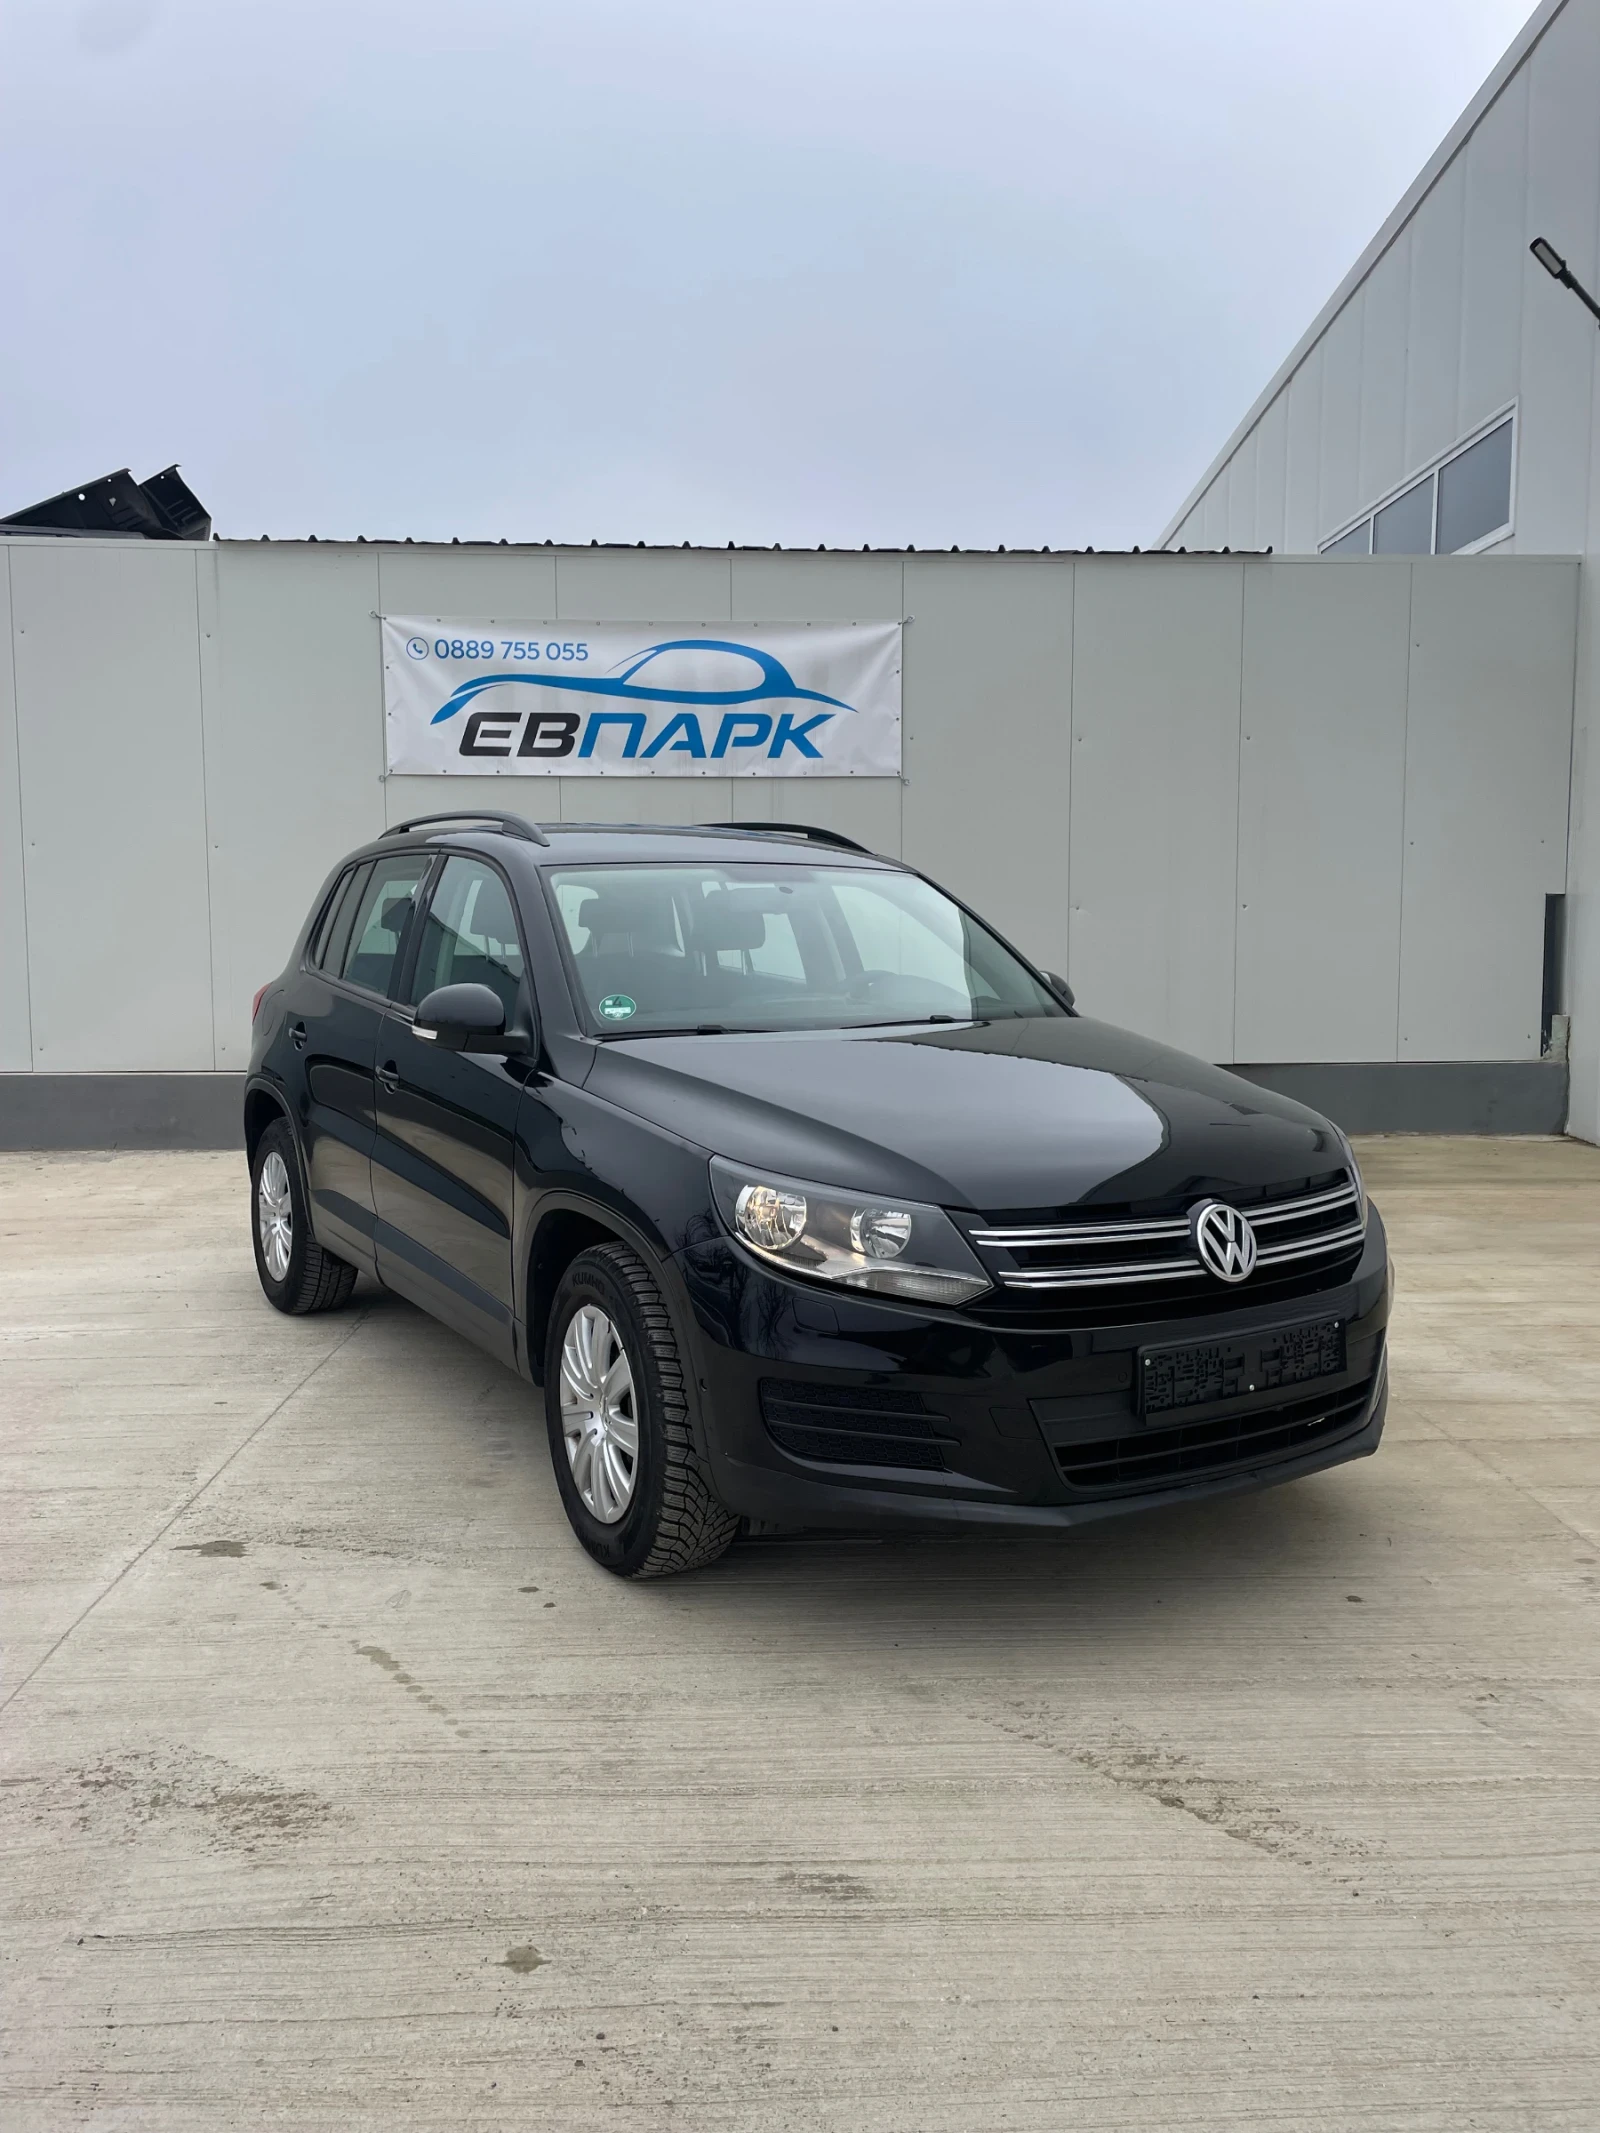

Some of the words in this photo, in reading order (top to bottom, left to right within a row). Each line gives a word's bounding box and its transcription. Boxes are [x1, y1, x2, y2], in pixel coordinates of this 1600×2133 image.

[434, 639, 495, 659] 0889
[501, 641, 540, 660] 755
[545, 642, 589, 661] 055
[458, 711, 837, 759] ЕВПАРК
[613, 996, 623, 1007] 4
[1200, 1207, 1254, 1278] VW
[572, 1272, 605, 1295] KUMHO
